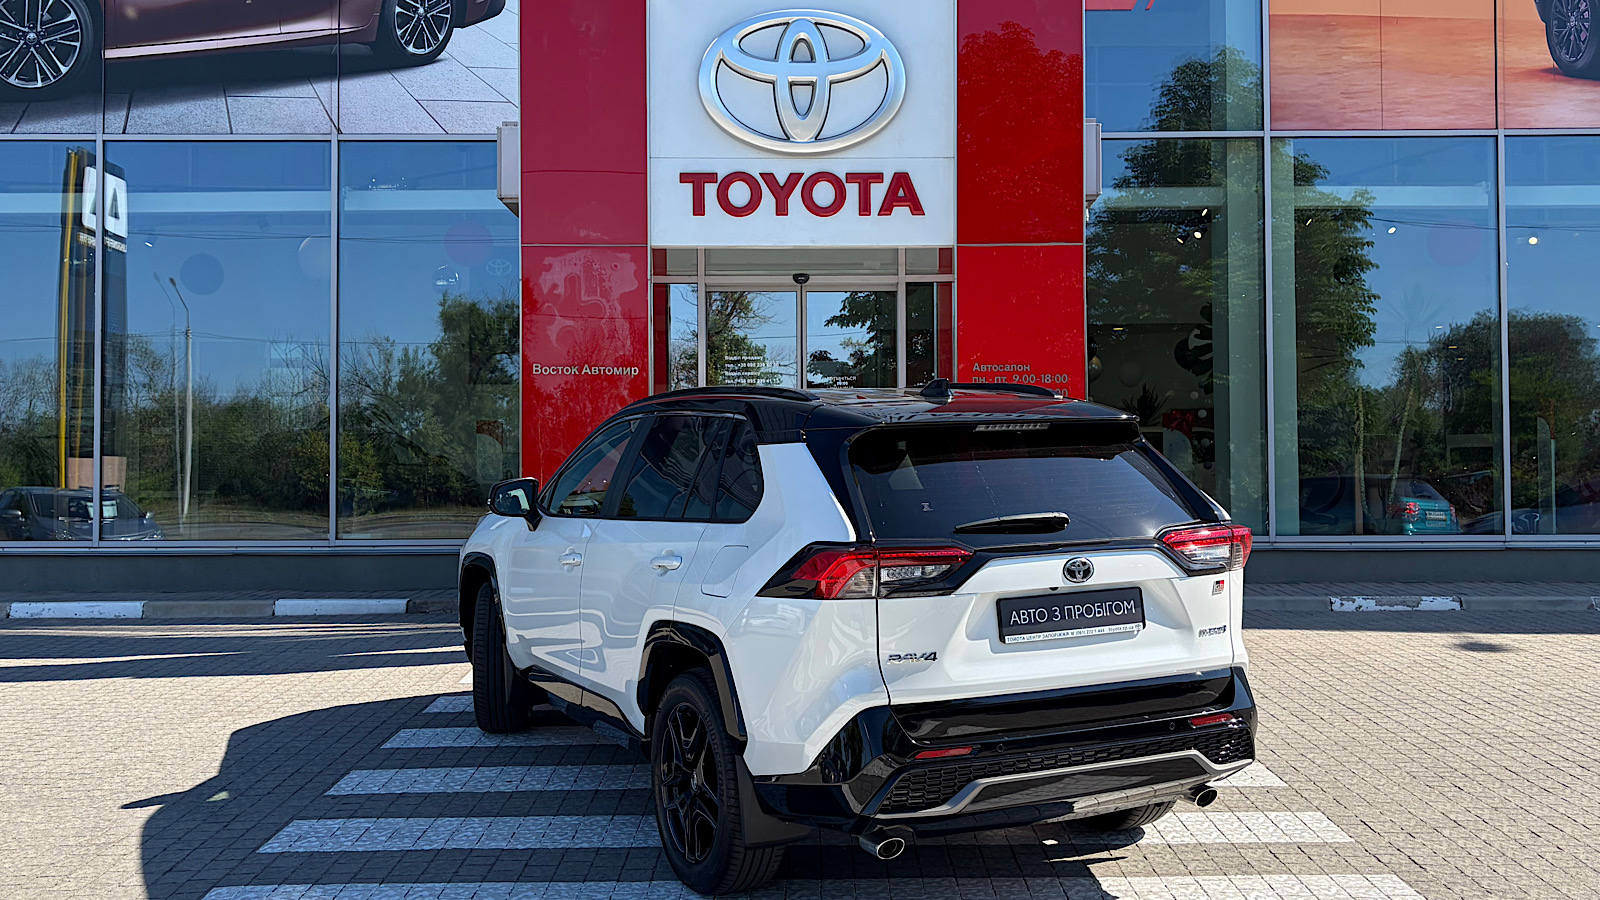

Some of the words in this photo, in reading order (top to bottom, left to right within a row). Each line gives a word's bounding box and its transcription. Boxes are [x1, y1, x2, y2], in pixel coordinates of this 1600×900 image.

[679, 171, 926, 217] TOYOTA
[532, 363, 579, 375] Восток
[581, 363, 639, 378] Автомир
[972, 362, 1031, 372] Автосалон
[1010, 607, 1048, 626] АВТО
[1064, 599, 1136, 620] ПРОБІГОМ
[886, 651, 938, 664] RAV4
